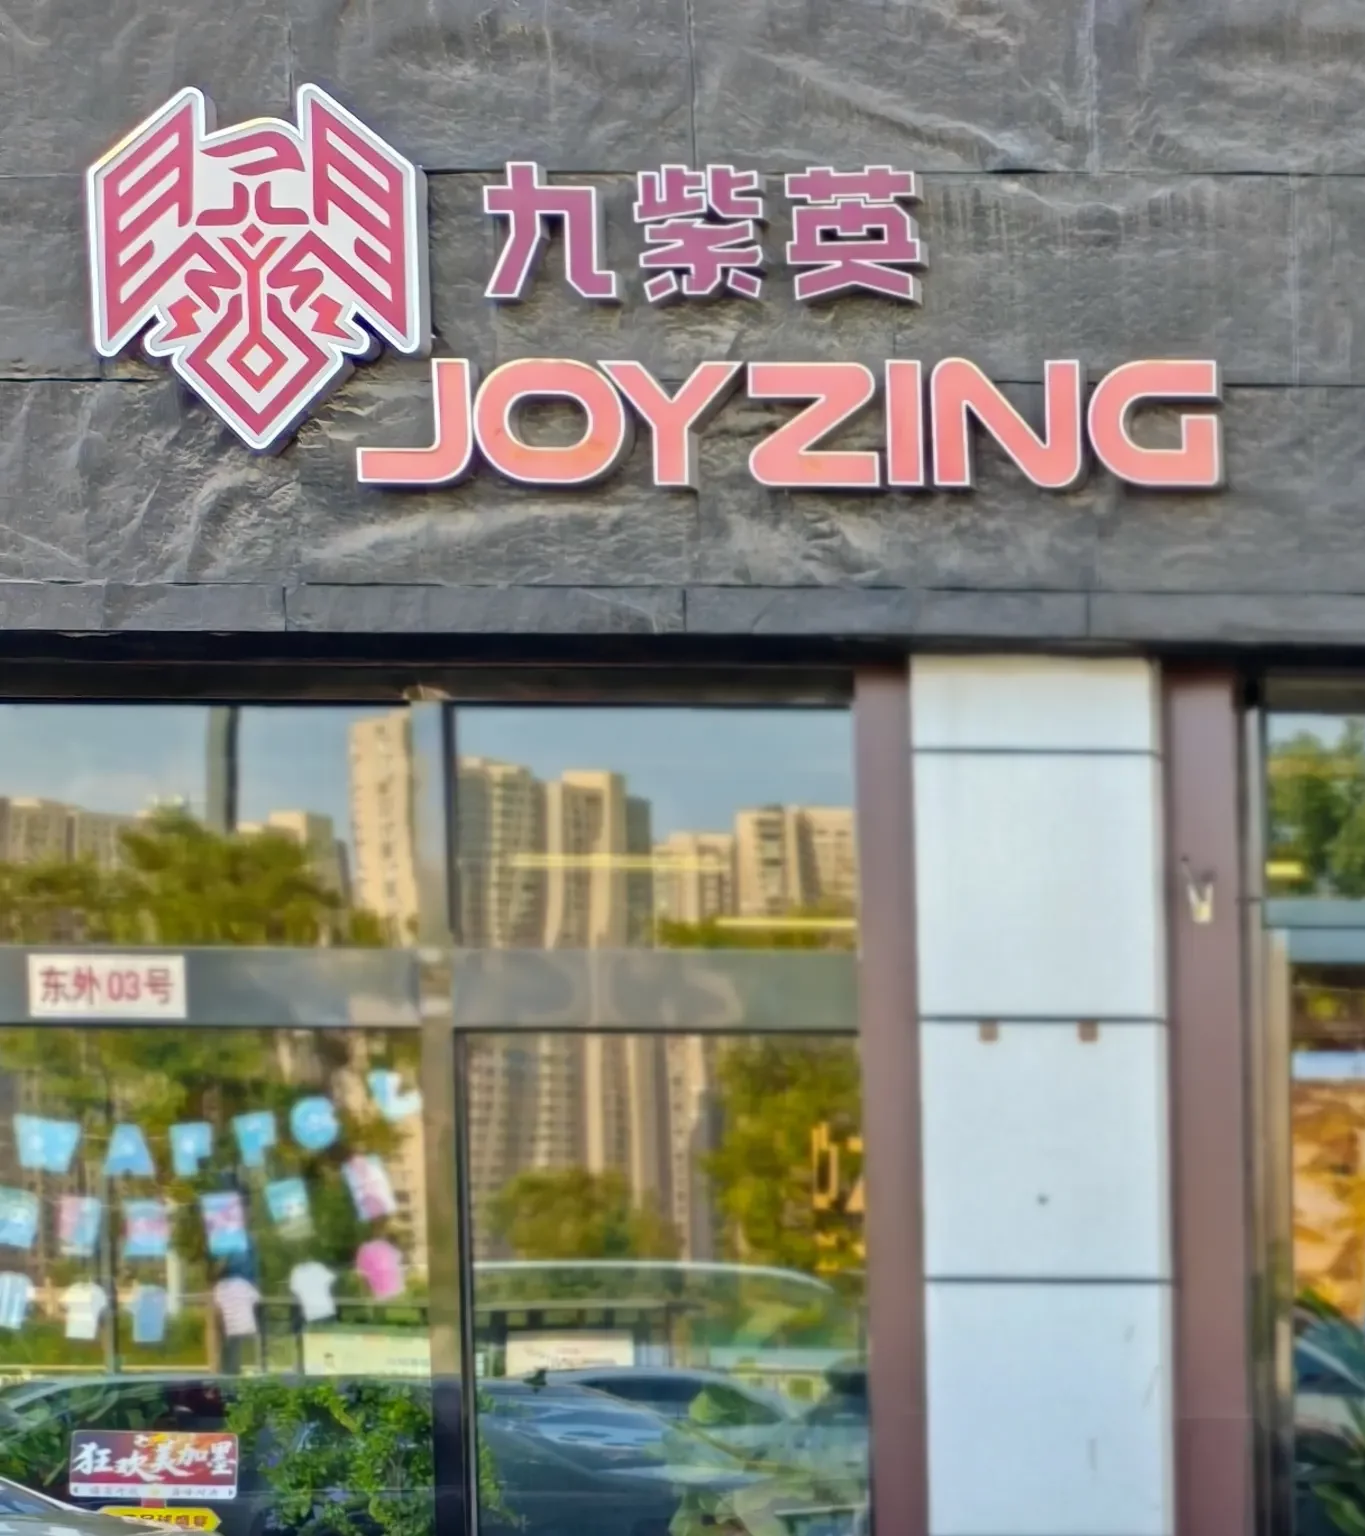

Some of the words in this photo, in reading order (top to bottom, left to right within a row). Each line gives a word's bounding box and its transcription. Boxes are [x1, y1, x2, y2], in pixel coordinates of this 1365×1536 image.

[483, 160, 924, 304] 九紫英
[355, 357, 1220, 490] JOYZING
[39, 965, 174, 1006] 东外03号
